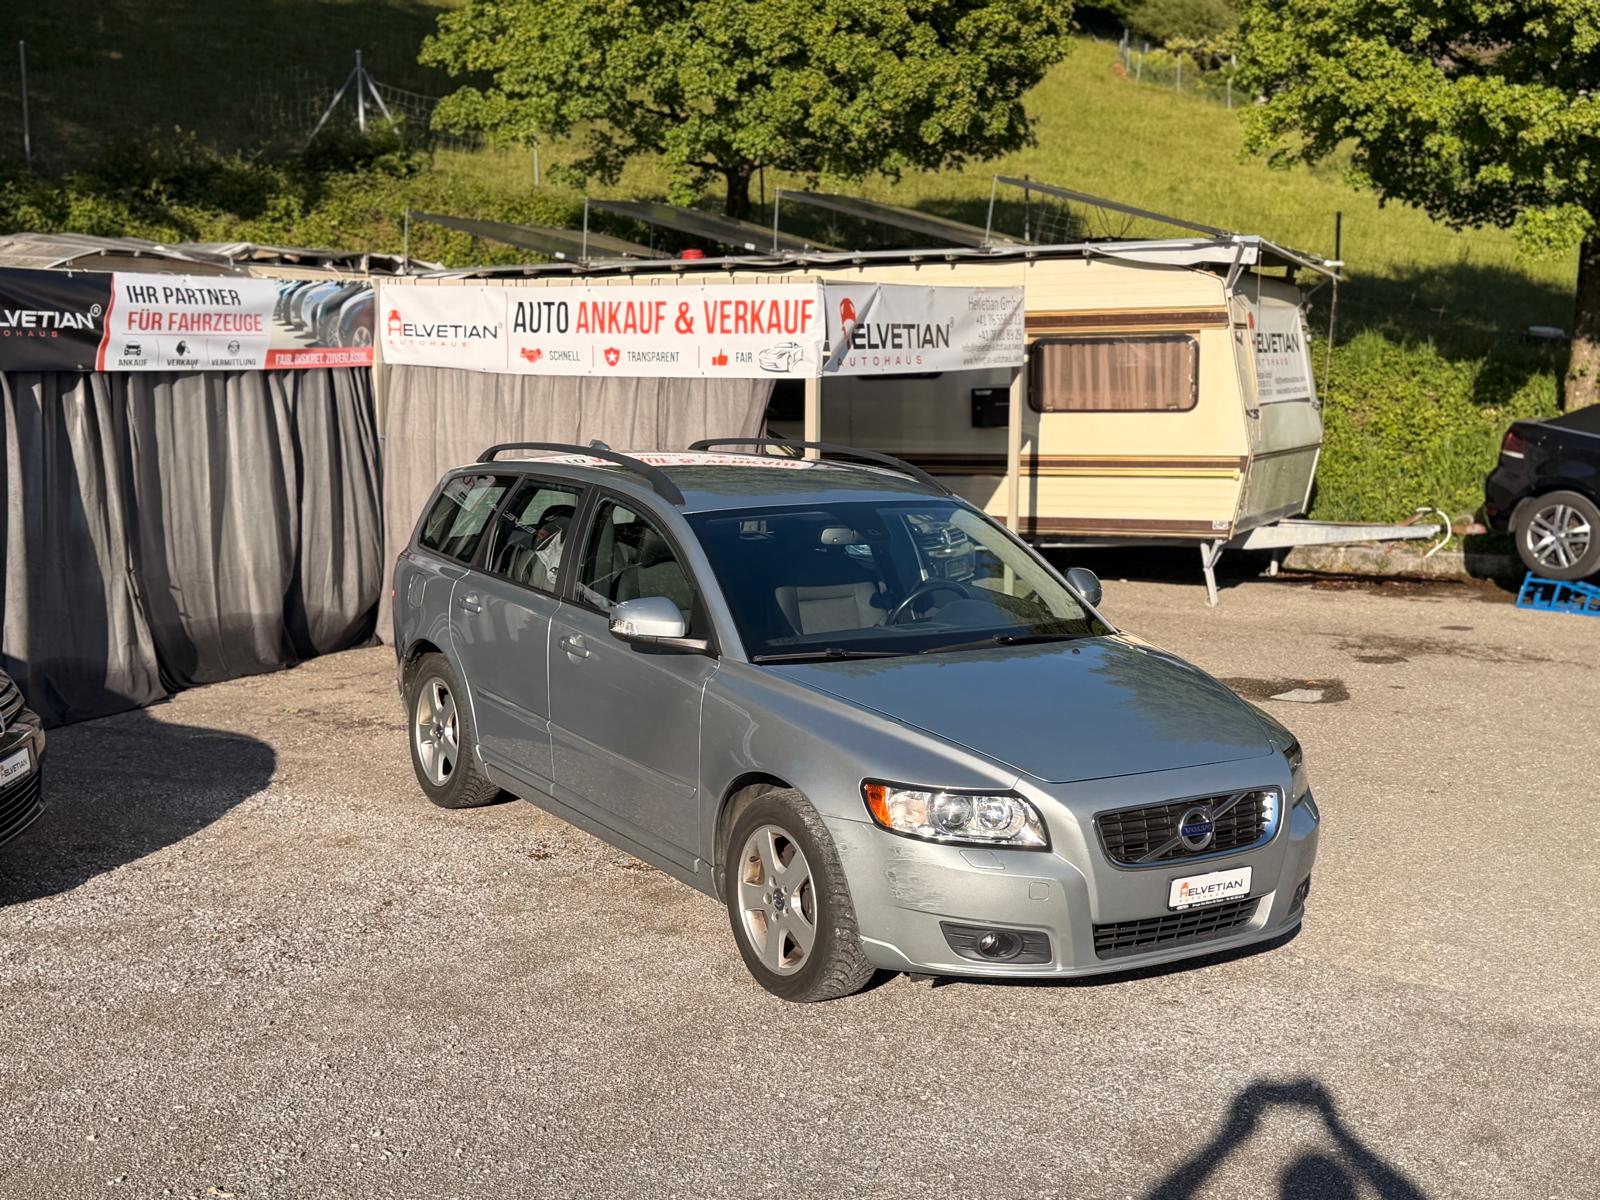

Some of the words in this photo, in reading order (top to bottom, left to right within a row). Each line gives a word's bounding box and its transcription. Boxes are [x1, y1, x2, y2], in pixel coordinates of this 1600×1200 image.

[126, 285, 159, 304] IHR
[162, 286, 241, 306] PARTNER
[128, 308, 163, 331] FÜR
[168, 312, 263, 331] FAHRZEUGE
[513, 301, 569, 334] AUTO
[576, 301, 667, 335] ANKAUF
[674, 301, 695, 335] &
[704, 299, 815, 335] VERKAUF
[388, 340, 468, 348] AUTOHAUS
[211, 357, 257, 367] VERMITTLUNG
[549, 350, 580, 362] SCHNELL
[627, 351, 681, 363] TRANSPARENT
[735, 351, 754, 363] FAIR
[837, 355, 924, 368] AUTOHAUS
[118, 358, 148, 367] ANKAUF
[167, 358, 200, 367] VERKAUF
[1183, 823, 1212, 834] VOLVO
[1180, 879, 1244, 899] HELVETIAN
